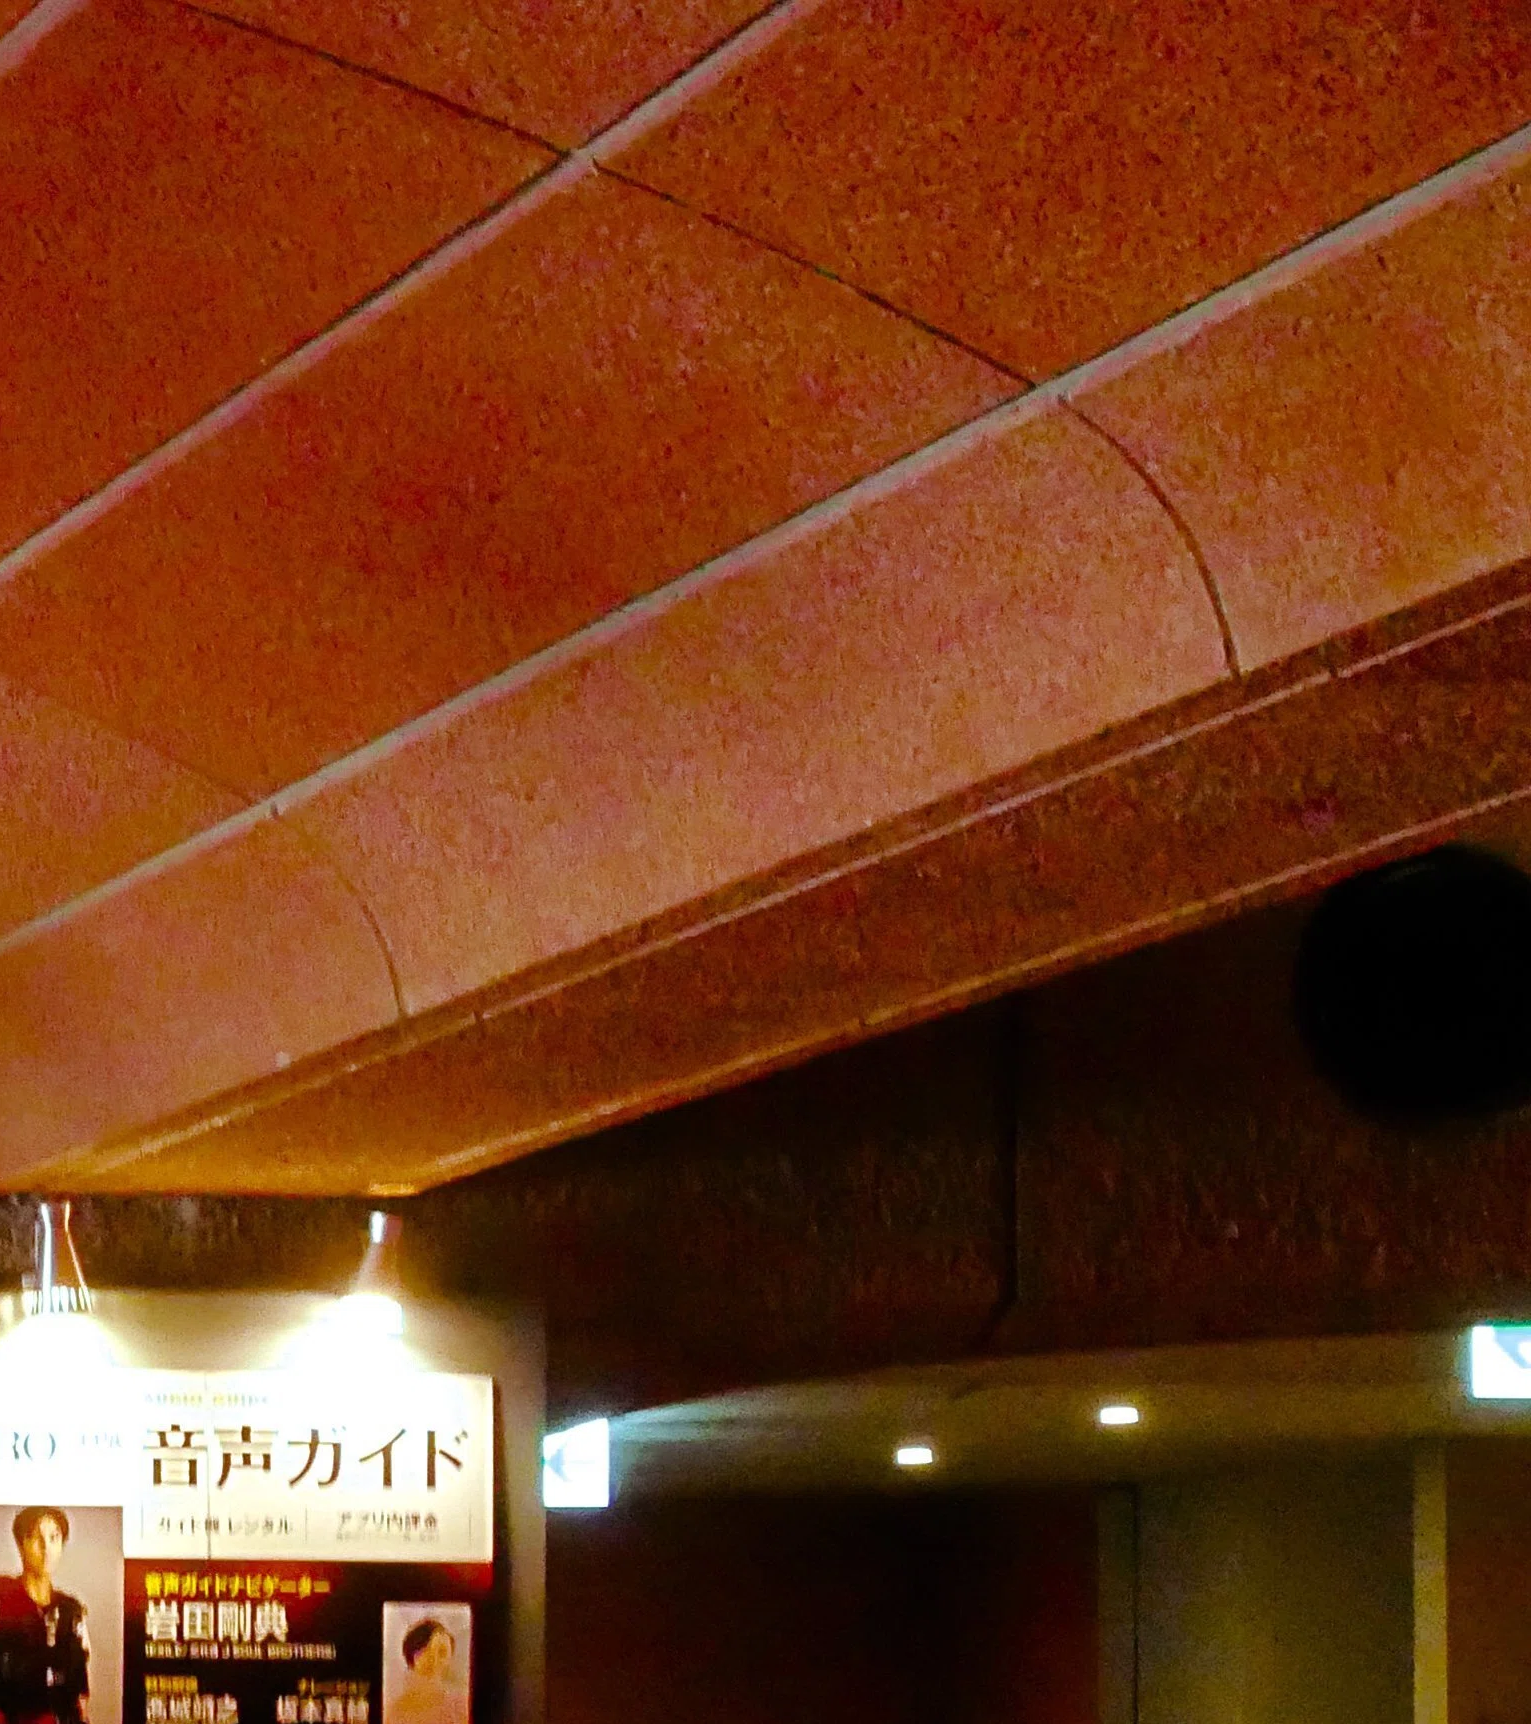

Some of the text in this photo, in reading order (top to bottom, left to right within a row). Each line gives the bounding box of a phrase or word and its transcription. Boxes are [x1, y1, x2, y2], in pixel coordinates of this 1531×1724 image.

[143, 1422, 469, 1488] 音声ガイド
